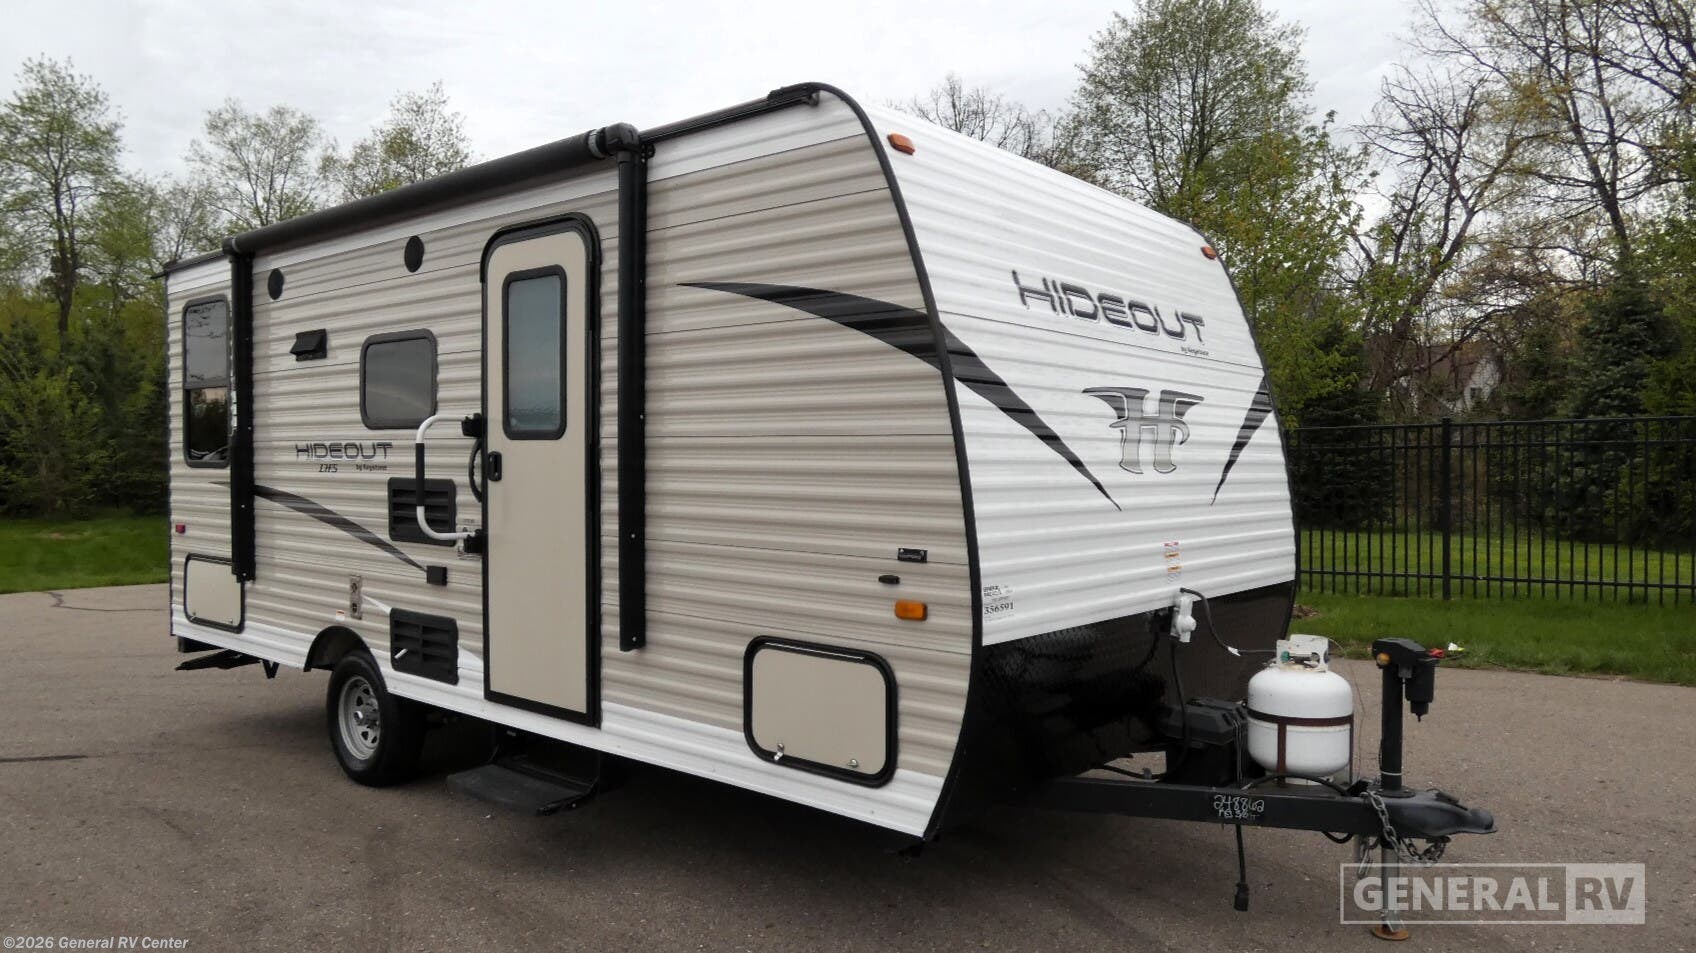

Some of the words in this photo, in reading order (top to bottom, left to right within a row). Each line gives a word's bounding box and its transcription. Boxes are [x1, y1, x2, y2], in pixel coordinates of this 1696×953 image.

[1011, 269, 1205, 345] HIDEOUT
[295, 442, 393, 460] HIDEOUT
[983, 602, 1014, 615] 356591
[1213, 794, 1265, 813] 248862
